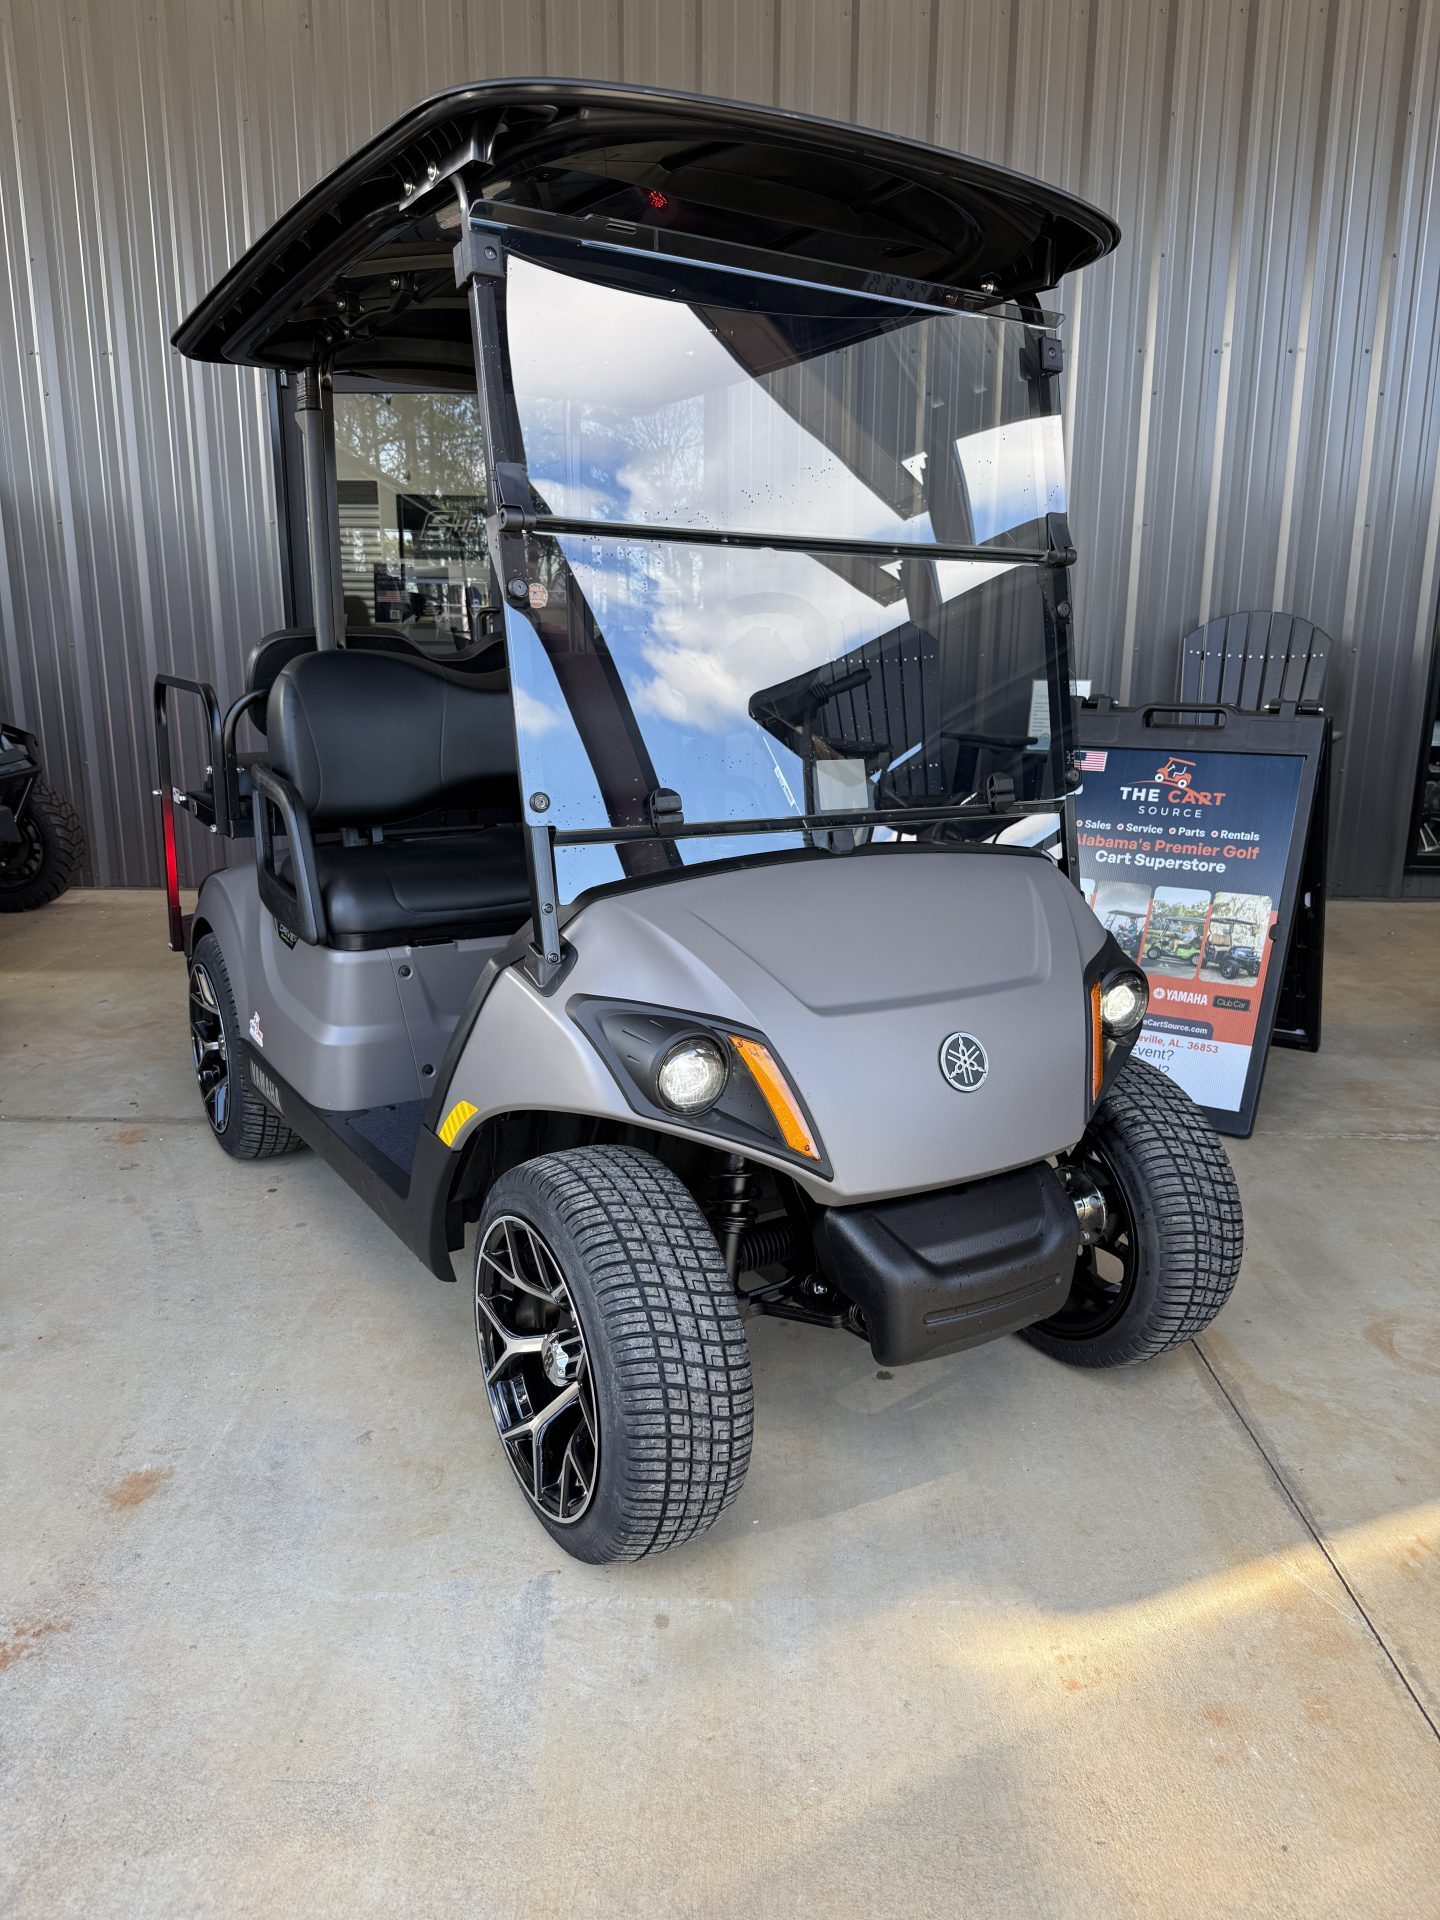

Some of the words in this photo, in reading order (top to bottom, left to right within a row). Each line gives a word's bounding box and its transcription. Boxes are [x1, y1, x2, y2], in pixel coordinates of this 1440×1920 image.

[1119, 786, 1161, 802] THE
[1168, 790, 1226, 806] CART
[1137, 805, 1203, 818] SOURCE
[1084, 819, 1111, 830] Sales
[1126, 823, 1163, 835] Service
[1178, 827, 1206, 838] Parts
[1220, 830, 1260, 842] Rentals
[1154, 837, 1220, 857] Premier
[1223, 845, 1260, 860] Golf
[1095, 849, 1131, 865] Cart
[1134, 853, 1226, 873] Superstore
[1166, 989, 1208, 1006] YAMAHA
[1187, 1041, 1219, 1054] 36853
[250, 1060, 282, 1113] YAMAHA
